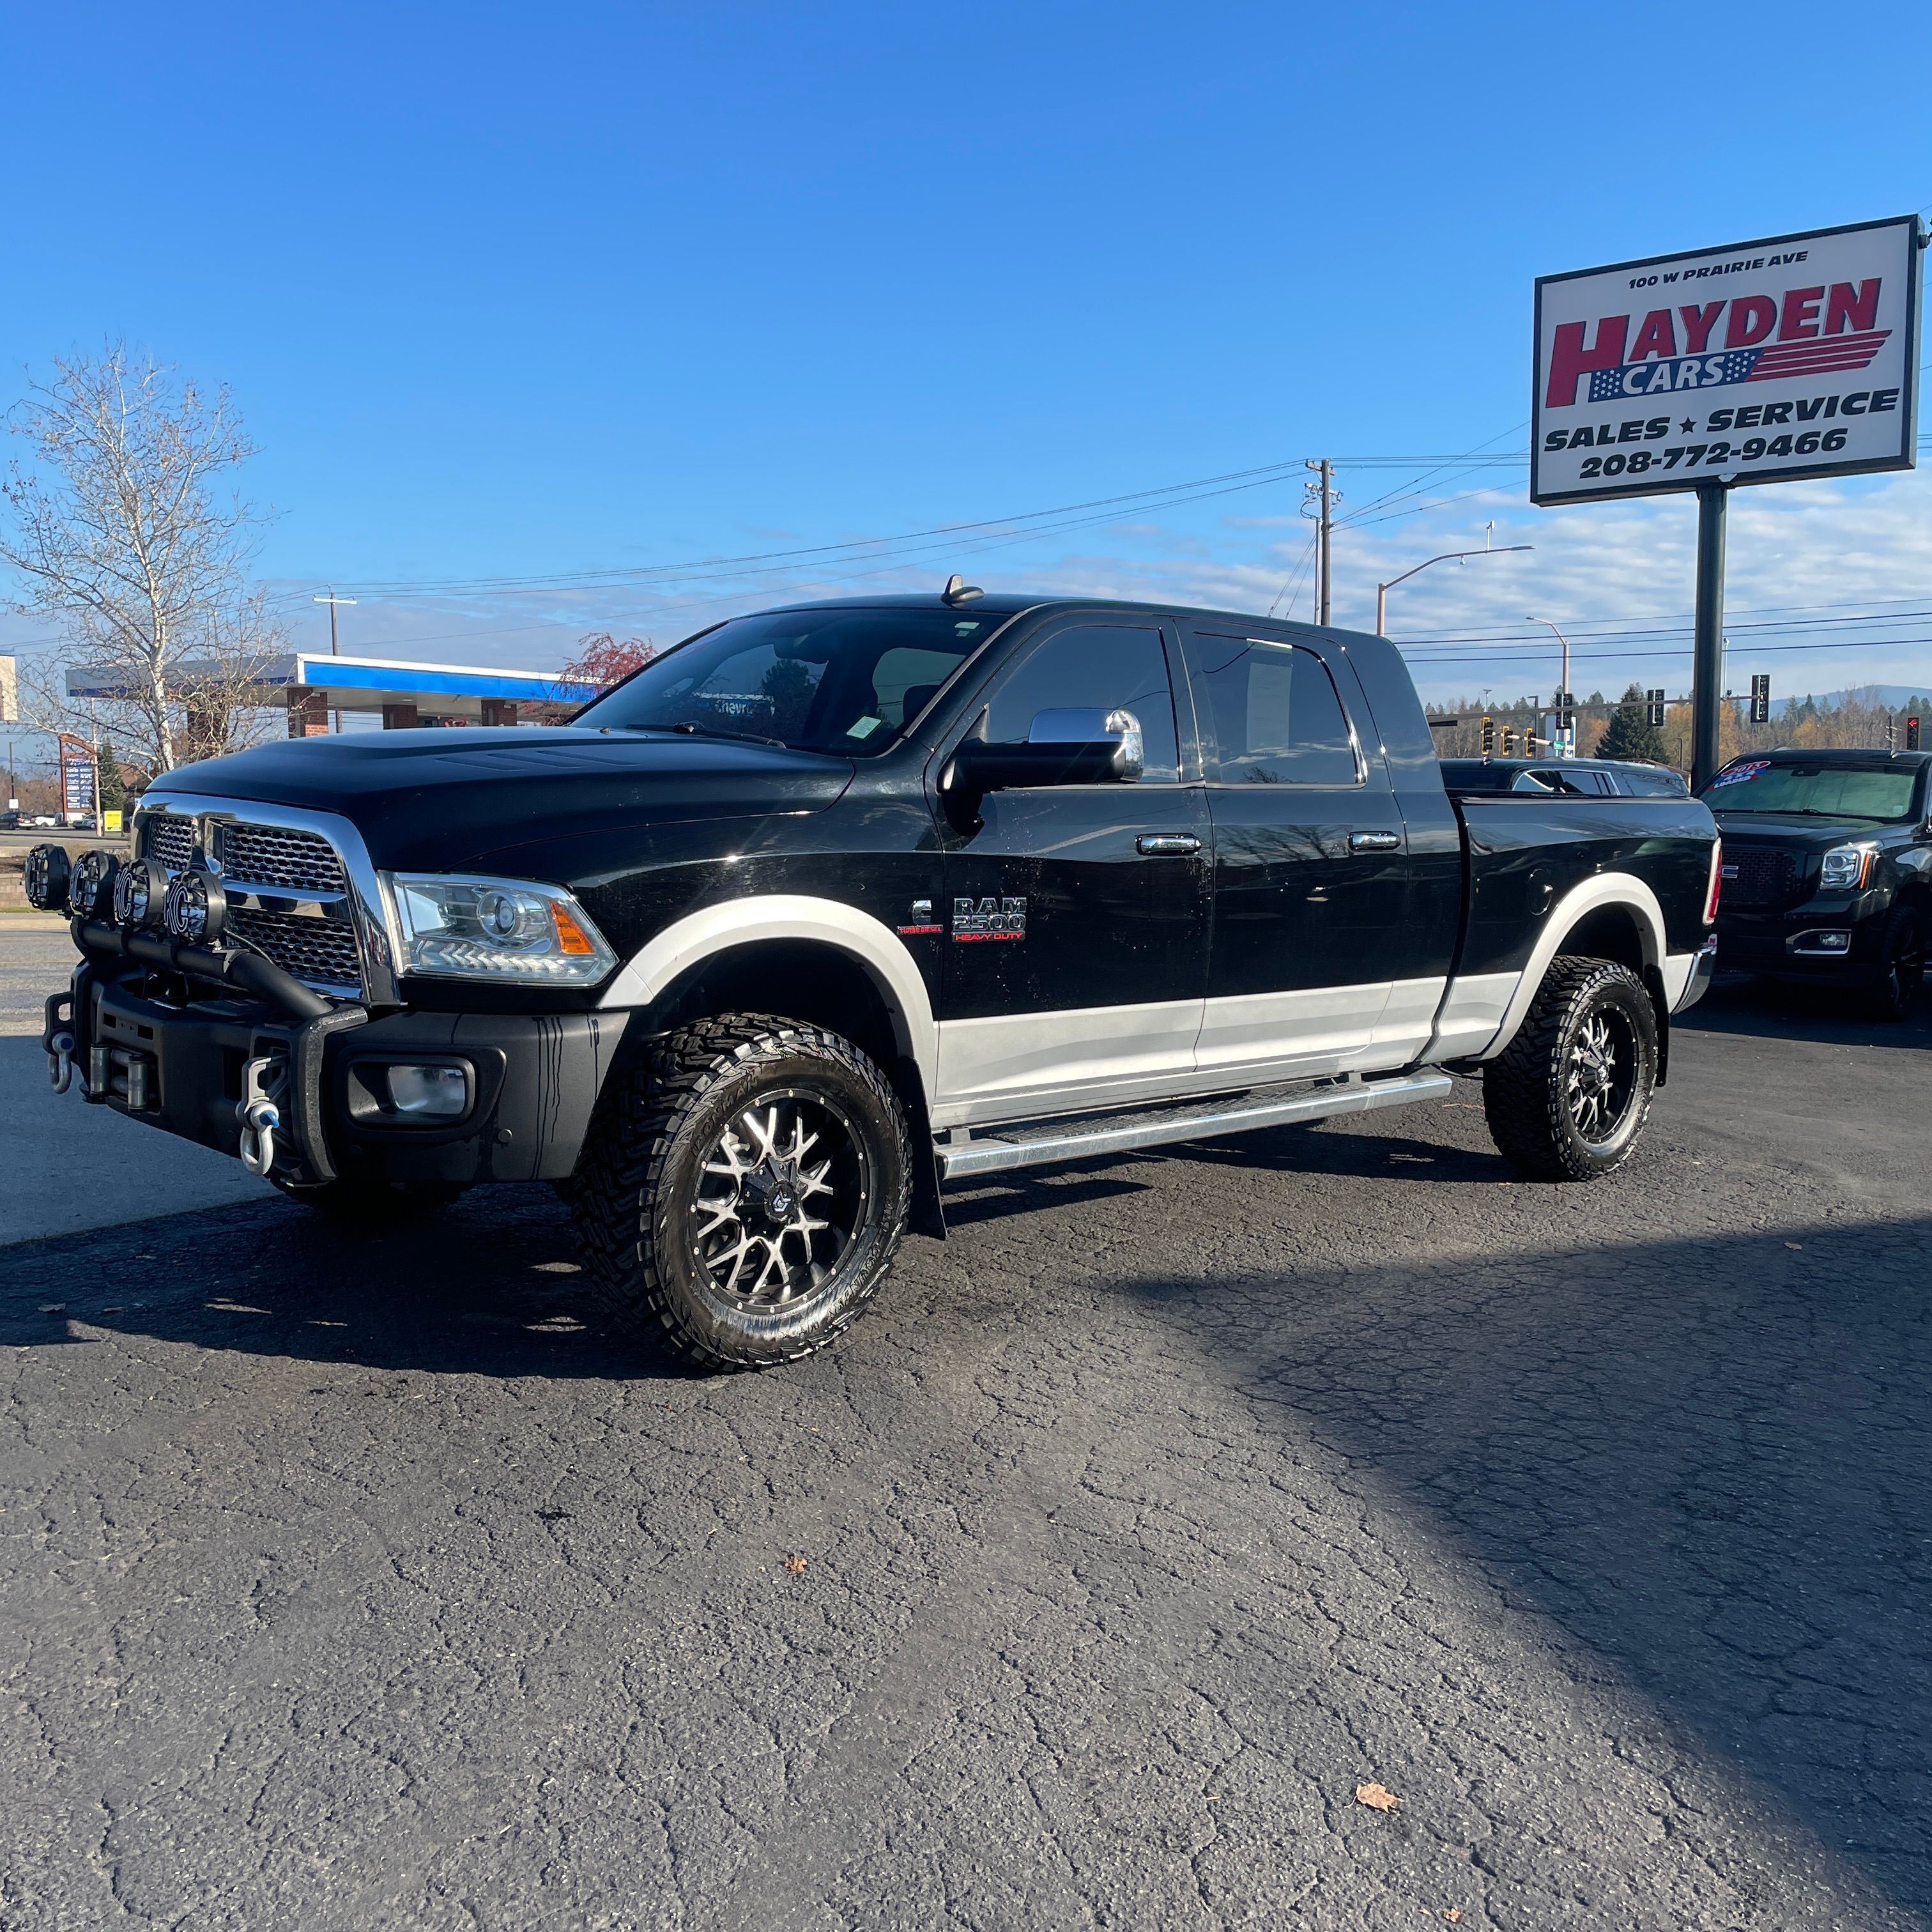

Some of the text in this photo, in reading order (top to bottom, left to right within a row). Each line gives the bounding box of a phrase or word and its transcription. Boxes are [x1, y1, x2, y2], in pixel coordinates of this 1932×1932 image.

[1629, 251, 1809, 289] 100 W PRAIRIE AVE
[1545, 278, 1882, 408] HAYDEN
[1621, 352, 1726, 394] CARS
[1544, 388, 1900, 452] SALES SERVICE
[1579, 429, 1848, 479] 208-772-9466
[164, 881, 188, 934] KC
[953, 914, 1026, 931] 2500
[954, 897, 1027, 914] RAM
[955, 933, 991, 941] HEAVY
